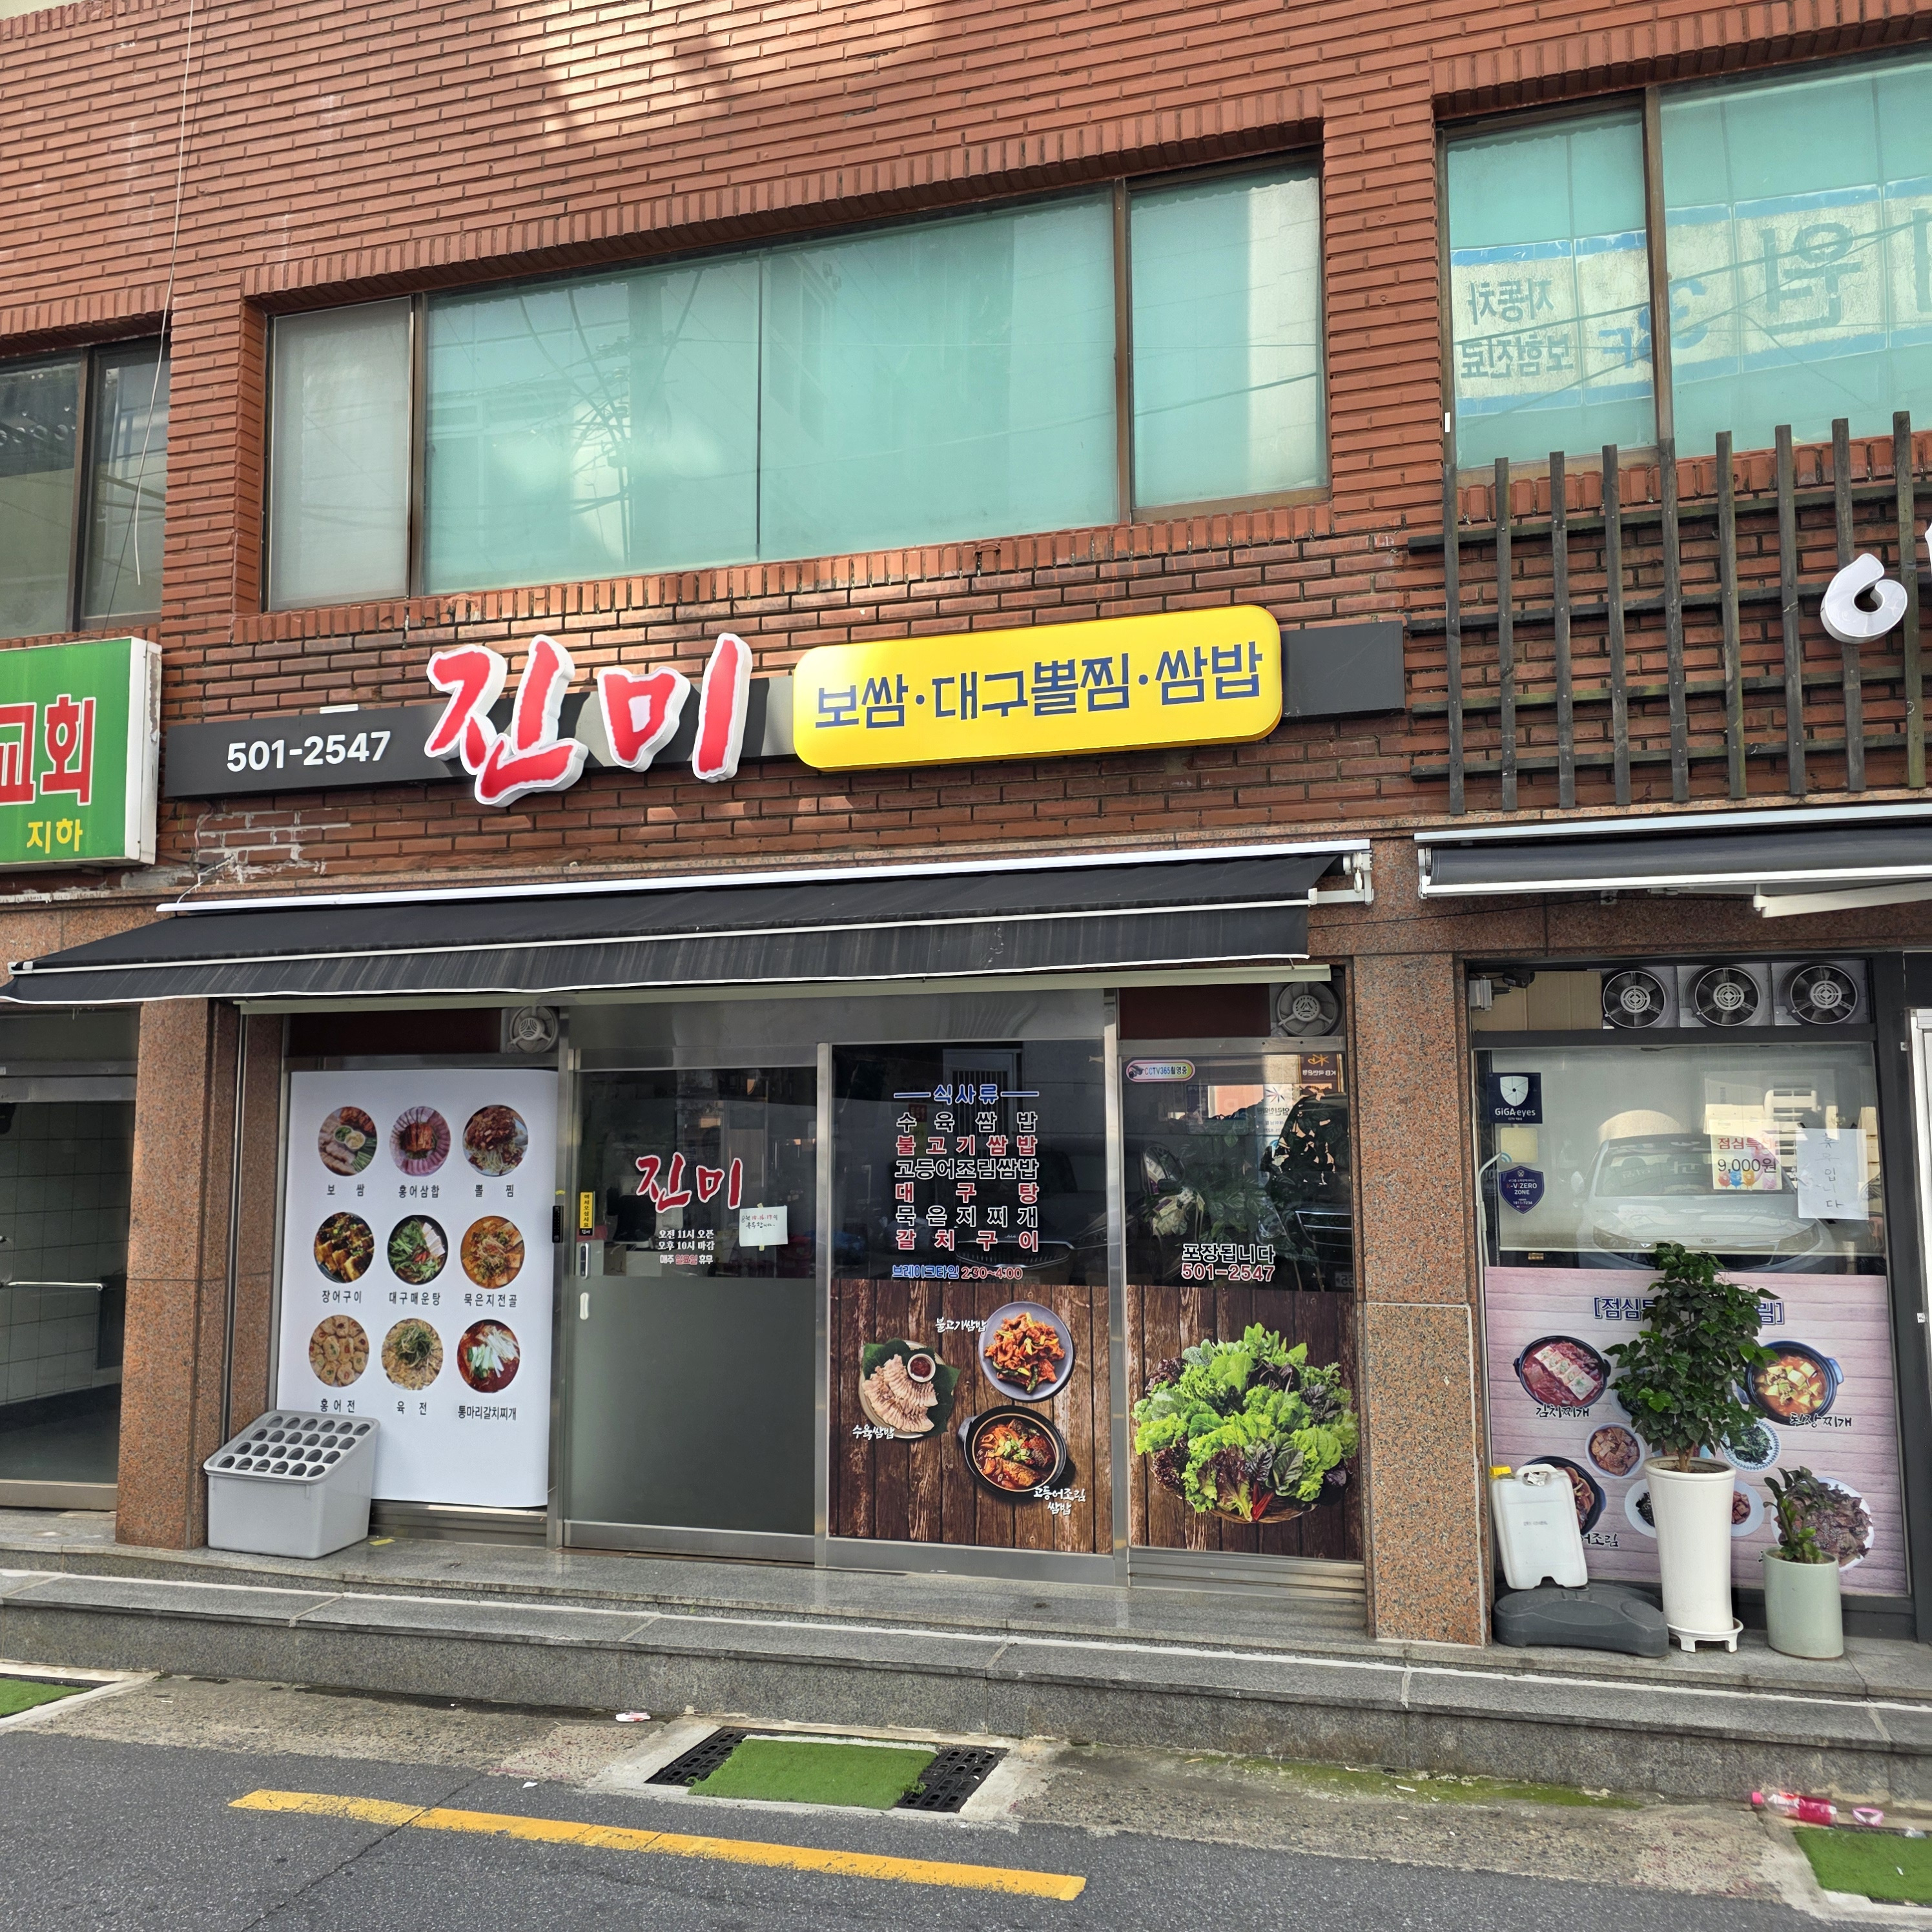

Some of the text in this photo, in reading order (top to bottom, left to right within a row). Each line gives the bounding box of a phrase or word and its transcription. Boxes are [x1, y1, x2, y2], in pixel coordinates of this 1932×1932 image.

[424, 632, 753, 807] 진미
[227, 731, 391, 772] 501-2547
[27, 818, 83, 854] 지하
[934, 1084, 999, 1105] 식사류
[894, 1158, 1040, 1180] 고등어조림쌈밥
[1718, 1158, 1777, 1174] 9,000원
[635, 1152, 743, 1213] 진미
[398, 1184, 440, 1198] 홍어삼합
[659, 1229, 715, 1239] 오전 11시 오픈
[657, 1241, 715, 1251] 오후 10시 마감
[1182, 1242, 1276, 1264] 포장됩니다
[660, 1255, 714, 1265] 매주 일요일 휴무
[892, 1265, 960, 1280] 브레이크타임
[1181, 1263, 1276, 1282] 501-2547
[322, 1290, 363, 1304] 장어구이
[389, 1292, 441, 1306] 대구매운탕
[464, 1294, 518, 1308] 묵은지전골
[934, 1317, 989, 1333] 불고기쌈밥
[320, 1399, 356, 1413] 홍어전
[457, 1405, 517, 1421] 통마리갈치찌개
[1536, 1403, 1590, 1419] 김치찌개
[1790, 1412, 1853, 1428] 된장찌개
[852, 1424, 896, 1441] 수육쌈밥
[1033, 1486, 1087, 1503] 고등어조림
[1047, 1501, 1073, 1516] 쌈밥
